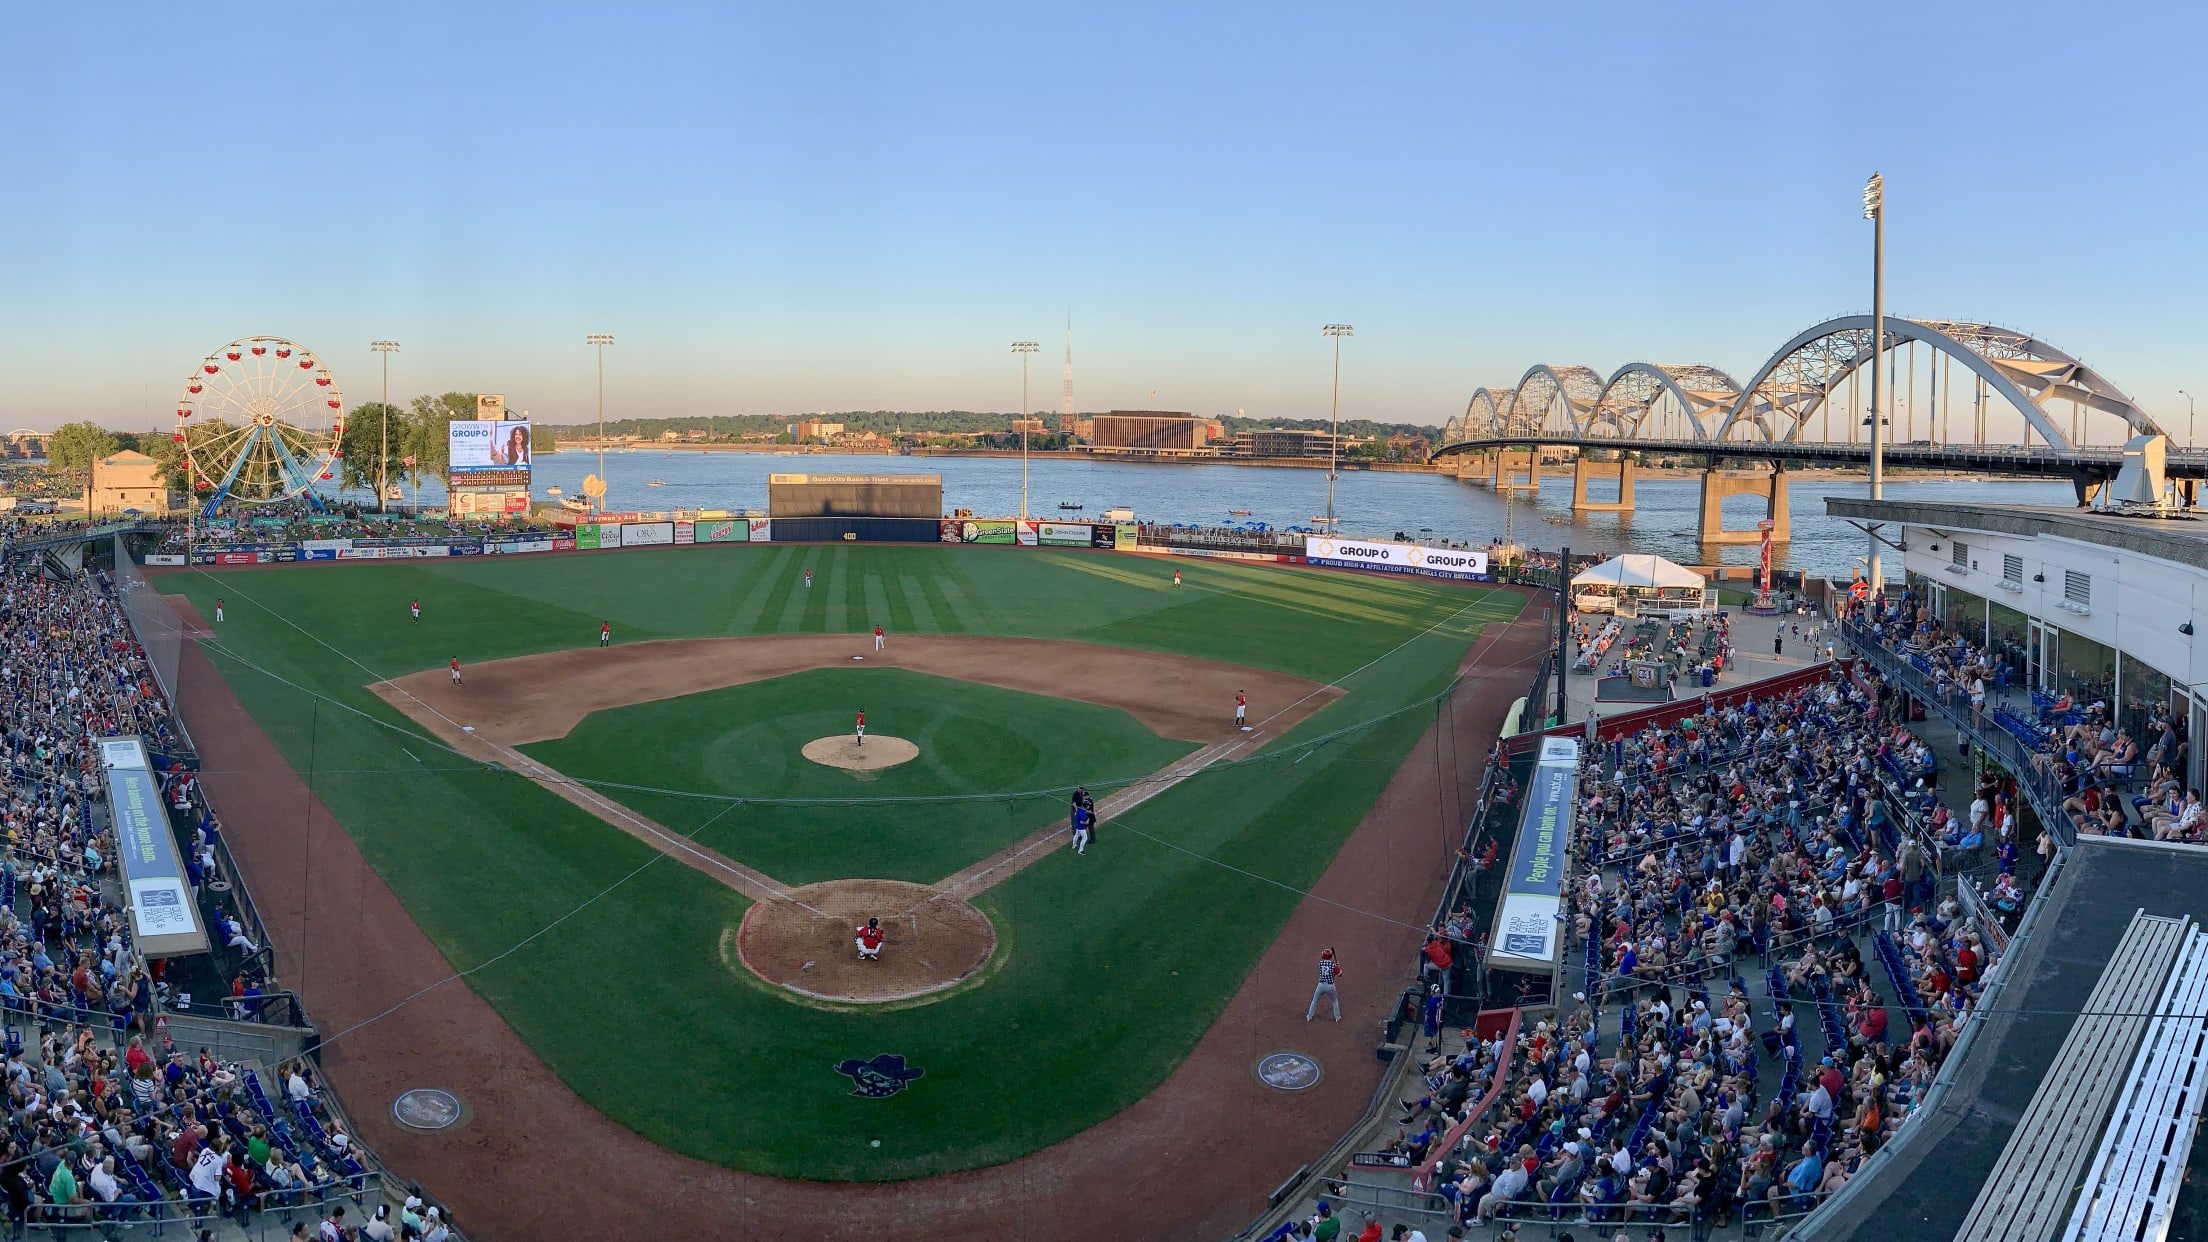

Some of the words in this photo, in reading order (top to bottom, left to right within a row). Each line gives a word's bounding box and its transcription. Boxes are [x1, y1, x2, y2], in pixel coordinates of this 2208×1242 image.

[1340, 546, 1378, 557] GROUP
[1366, 563, 1394, 572] AFFILIATE
[1427, 555, 1466, 566] GROUP
[128, 790, 144, 809] banking
[135, 817, 151, 826] the
[1536, 816, 1556, 831] bank
[137, 827, 152, 844] home
[1538, 831, 1553, 842] can
[141, 845, 156, 863] team.
[1536, 843, 1555, 856] you
[1526, 856, 1553, 882] People
[172, 907, 183, 921] QUAD
[1509, 917, 1520, 932] QUAD
